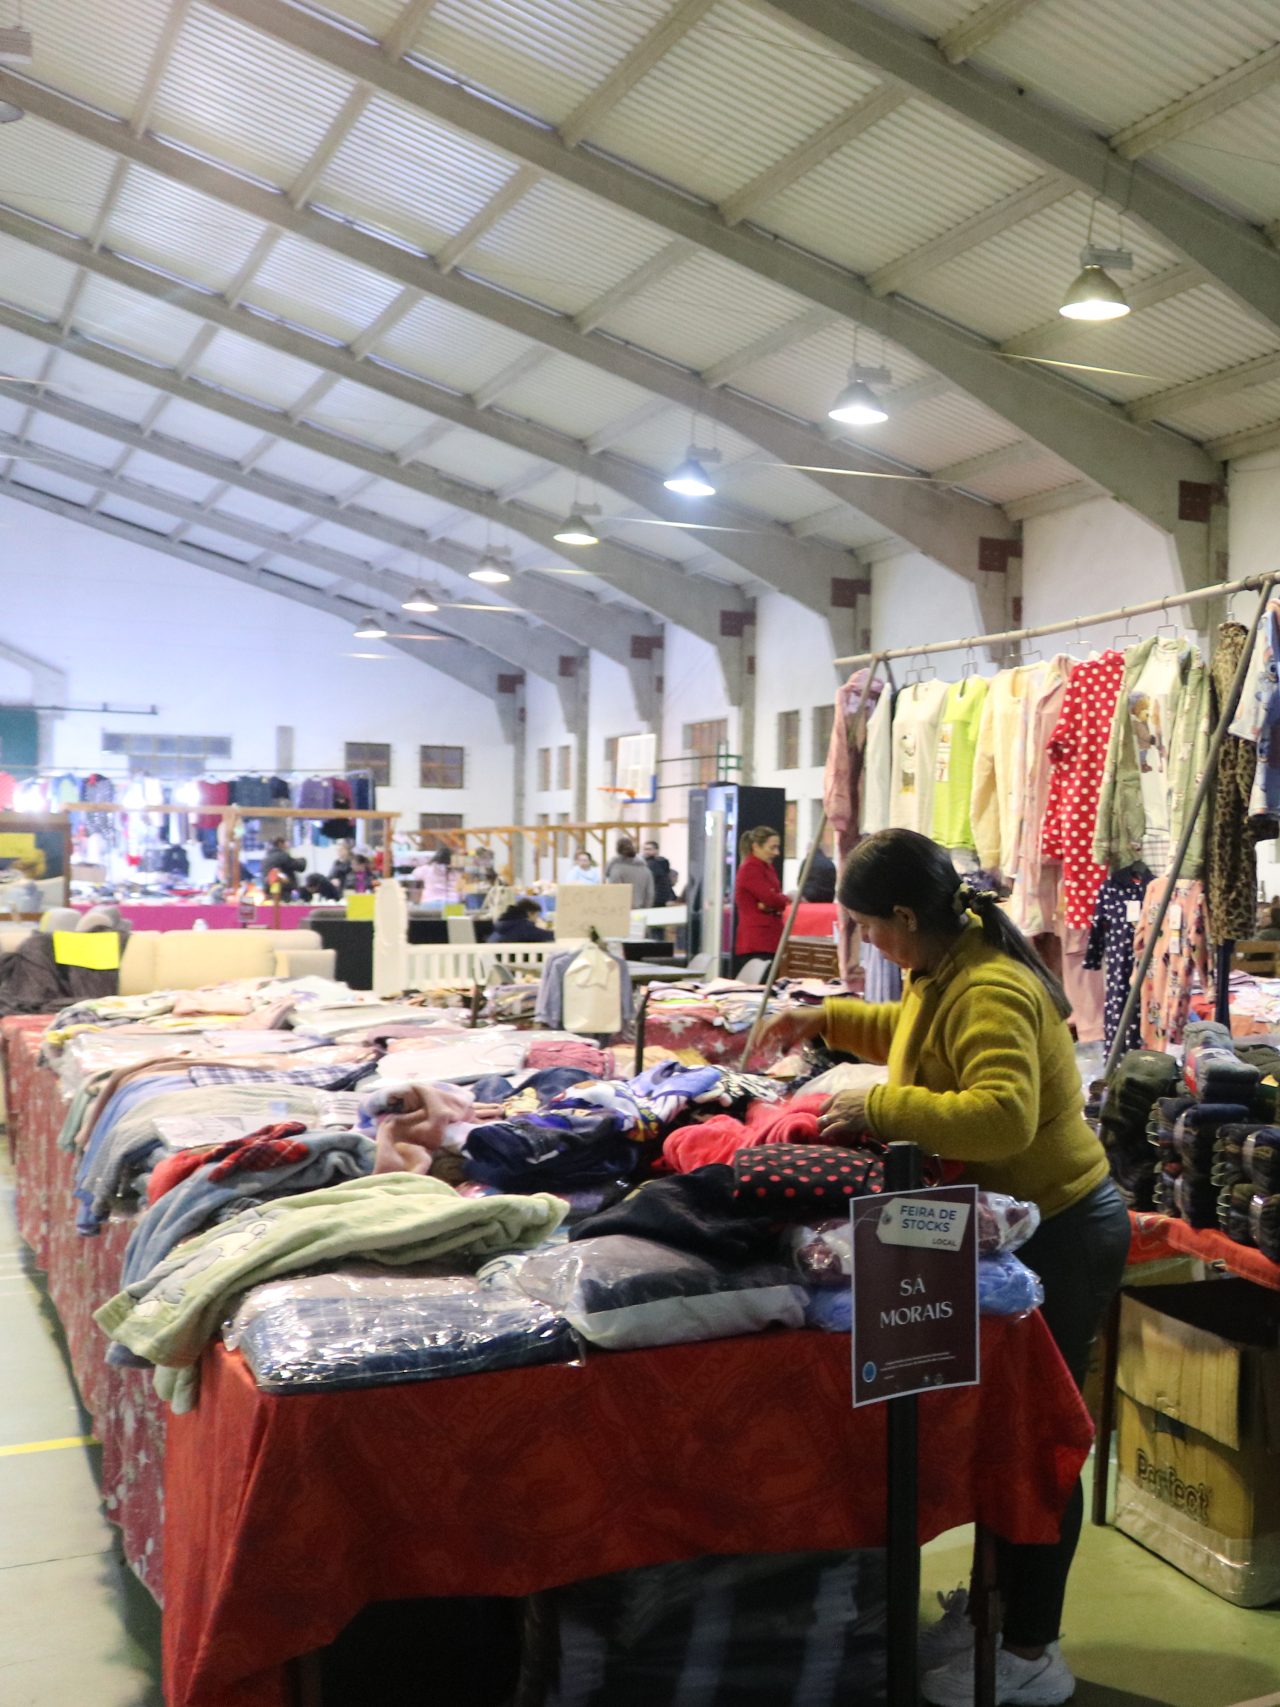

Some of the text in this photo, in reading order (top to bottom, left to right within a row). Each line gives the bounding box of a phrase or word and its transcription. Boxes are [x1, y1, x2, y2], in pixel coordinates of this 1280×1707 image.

[900, 1204, 957, 1221] FEIRA DE
[901, 1218, 950, 1233] STOCKS
[932, 1238, 957, 1247] LOCAL
[899, 1273, 927, 1297] SÁ
[880, 1300, 954, 1329] MORAIS
